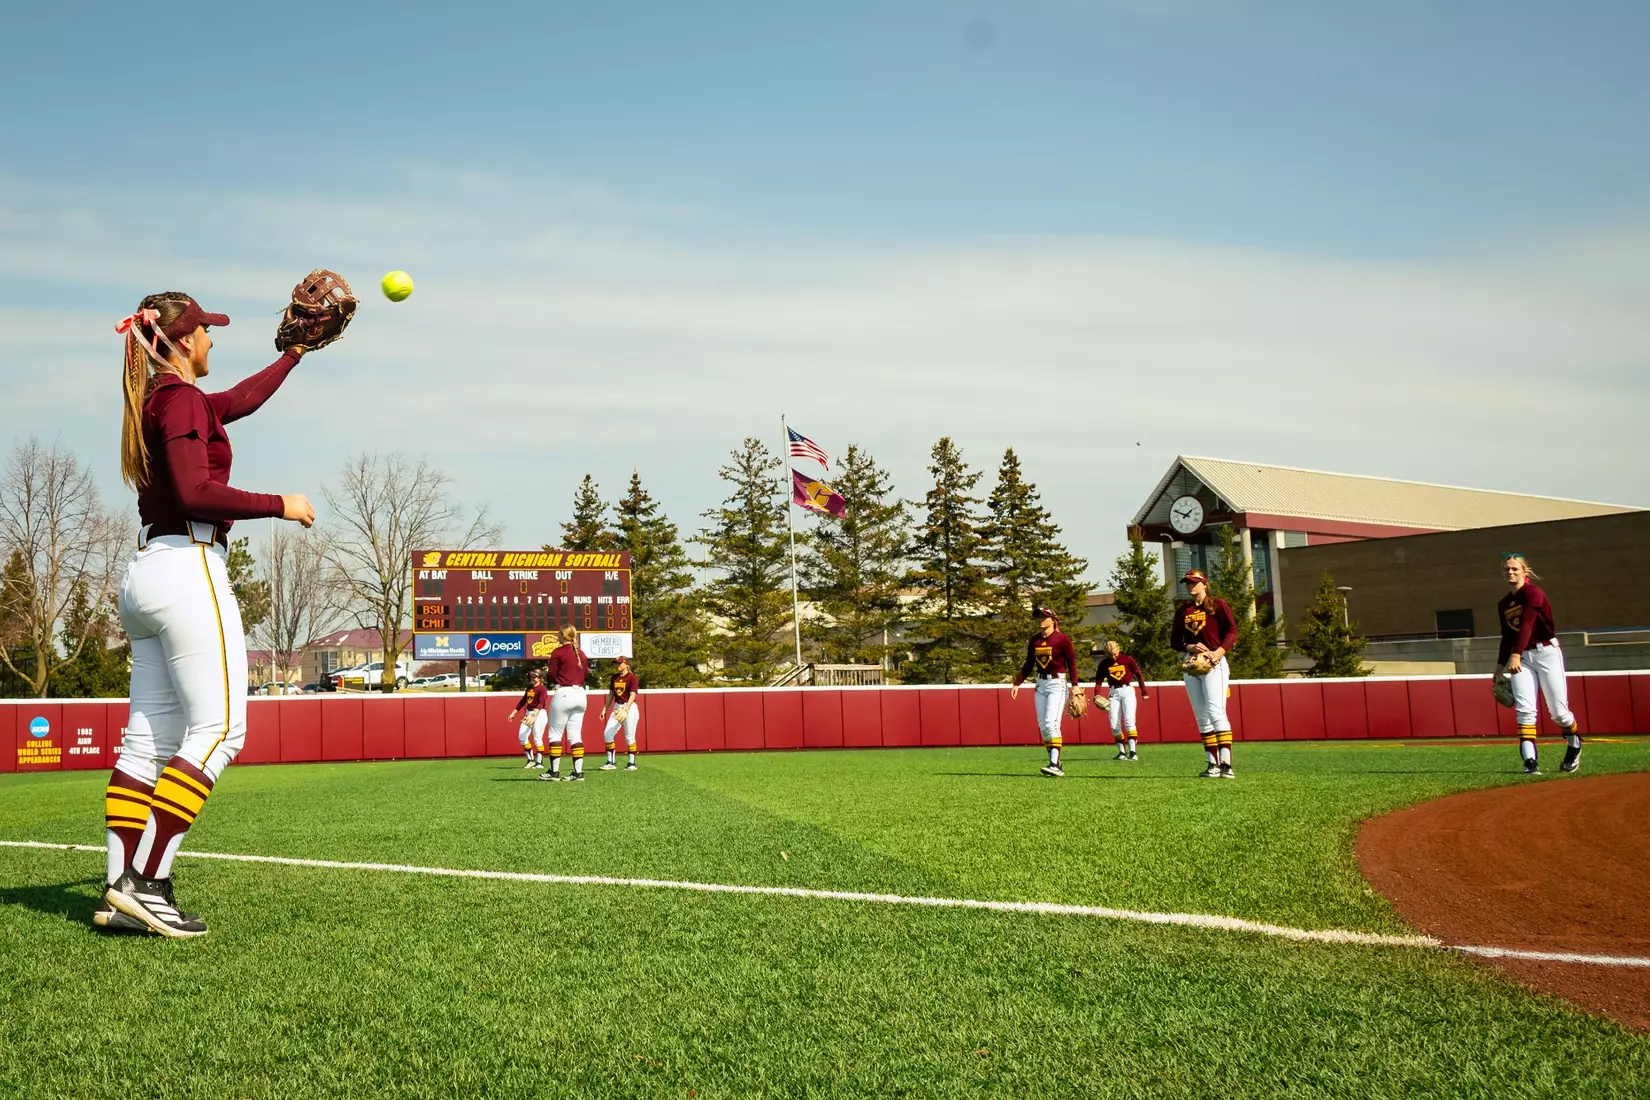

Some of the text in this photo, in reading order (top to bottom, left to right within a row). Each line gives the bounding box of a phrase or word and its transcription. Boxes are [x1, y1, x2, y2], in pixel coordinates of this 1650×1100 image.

[445, 552, 621, 567] CENTRAL MICHIGAN SOFTBALL
[418, 570, 448, 580] AT BAT
[471, 570, 493, 580] BALL
[508, 570, 538, 580] STRIKE
[555, 570, 573, 580] OUT
[604, 570, 619, 580] H/E
[456, 596, 630, 604] 1 2 3 4 5 6 7 8 9 10 RUNS HITS ERR
[422, 605, 444, 615] BSU
[422, 619, 444, 628] CMU
[492, 641, 521, 652] pepsi
[592, 637, 620, 647] MEMBERS
[26, 740, 52, 748] COLLEGE
[17, 748, 62, 756] WORLD SERIES
[82, 746, 100, 754] PLACE
[18, 756, 61, 764] APPEARANCES
